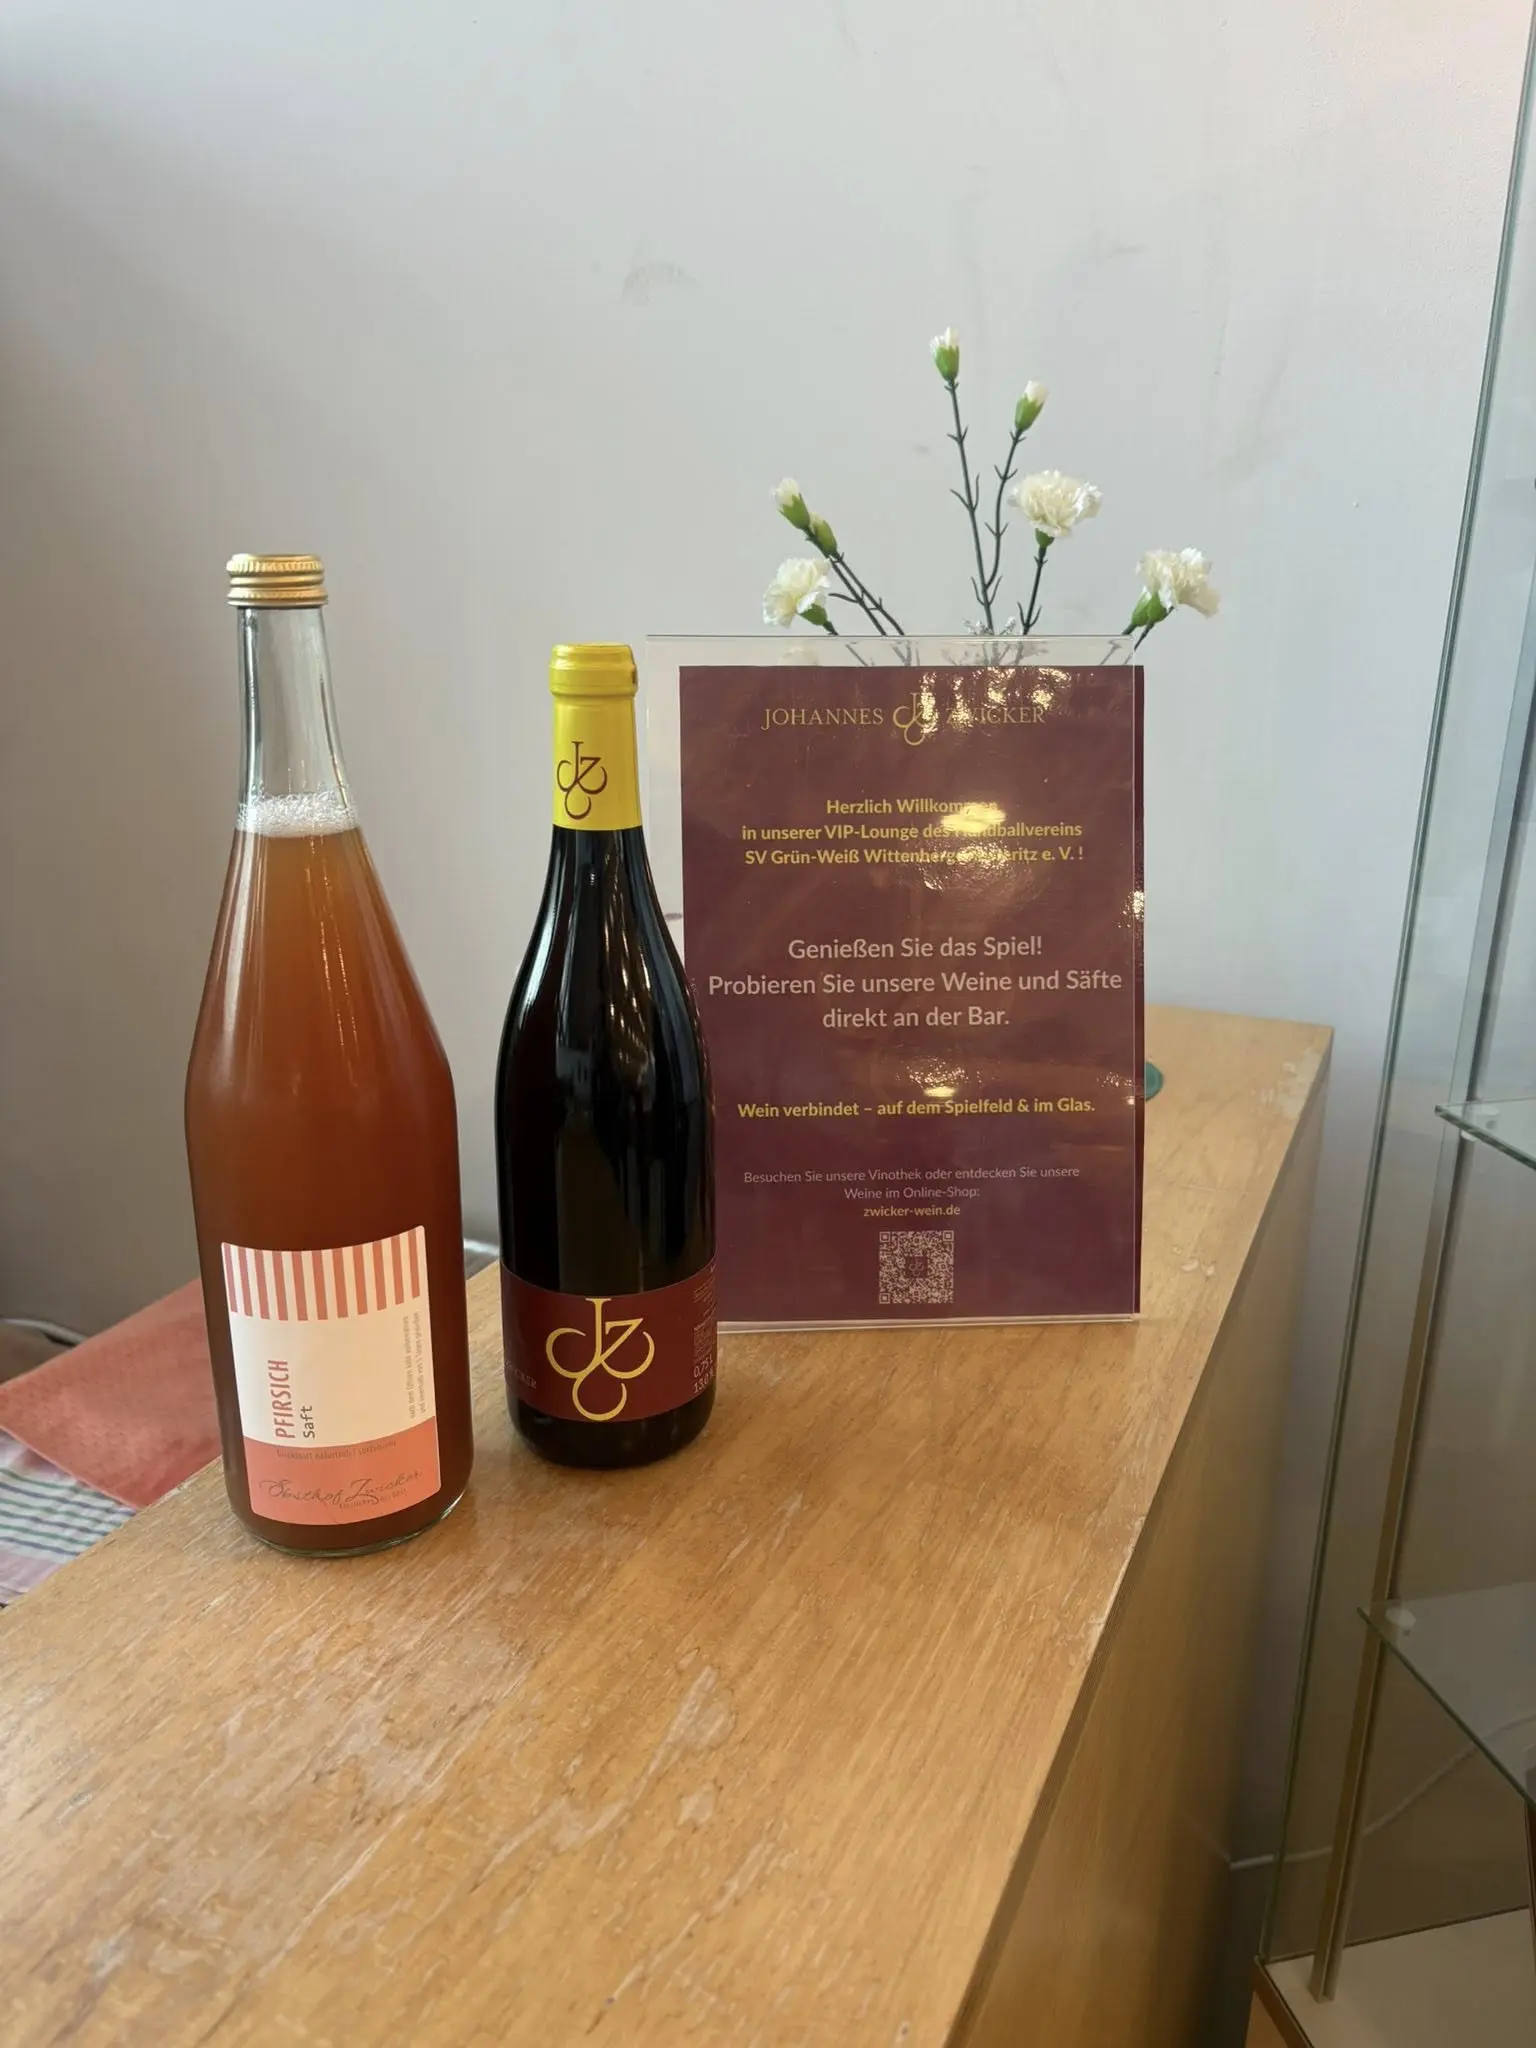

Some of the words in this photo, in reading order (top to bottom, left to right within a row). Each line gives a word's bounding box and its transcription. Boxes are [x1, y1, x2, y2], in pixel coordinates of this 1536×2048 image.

[761, 707, 884, 731] JOHANNES
[826, 798, 893, 815] Herzlich
[741, 825, 757, 841] in
[760, 826, 822, 841] unserer
[825, 824, 919, 843] VIP-Lounge
[922, 823, 950, 839] des
[743, 850, 768, 865] SV
[771, 848, 860, 865] Grün-Weiß
[1040, 848, 1056, 862] e.
[1058, 846, 1075, 861] V.
[787, 938, 894, 960] Genießen
[900, 937, 934, 958] Sie
[939, 936, 977, 957] das
[983, 935, 1043, 960] Spiel!
[708, 974, 816, 995] Probieren
[822, 973, 855, 993] Sie
[861, 975, 935, 993] unsere
[941, 971, 1012, 991] Weine
[1018, 969, 1059, 990] und
[1065, 968, 1123, 989] Säfte
[822, 1007, 887, 1028] direkt
[893, 1010, 920, 1027] an
[925, 1006, 961, 1026] der
[968, 1006, 1010, 1025] Bar.
[737, 1103, 779, 1118] Wein
[782, 1101, 860, 1118] verbindet
[876, 1099, 903, 1116] auf
[905, 1099, 941, 1116] dem
[944, 1097, 1013, 1117] Spielfeld
[1017, 1098, 1030, 1113] &
[1033, 1097, 1053, 1113] im
[1056, 1096, 1096, 1112] Glas.
[743, 1171, 802, 1184] Besuchen
[804, 1170, 823, 1183] Sie
[825, 1172, 866, 1183] unsere
[868, 1169, 922, 1182] Vinothek
[924, 1168, 953, 1181] oder
[954, 1167, 1017, 1181] entdecken
[1018, 1167, 1037, 1180] Sie
[1039, 1168, 1081, 1179] unsere
[843, 1187, 883, 1200] Weine
[885, 1187, 901, 1199] im
[902, 1185, 980, 1200] Online-Shop:
[863, 1204, 961, 1218] zwicker-wein.de
[267, 1359, 296, 1439] PFIRSICH
[301, 1404, 316, 1440] Saft
